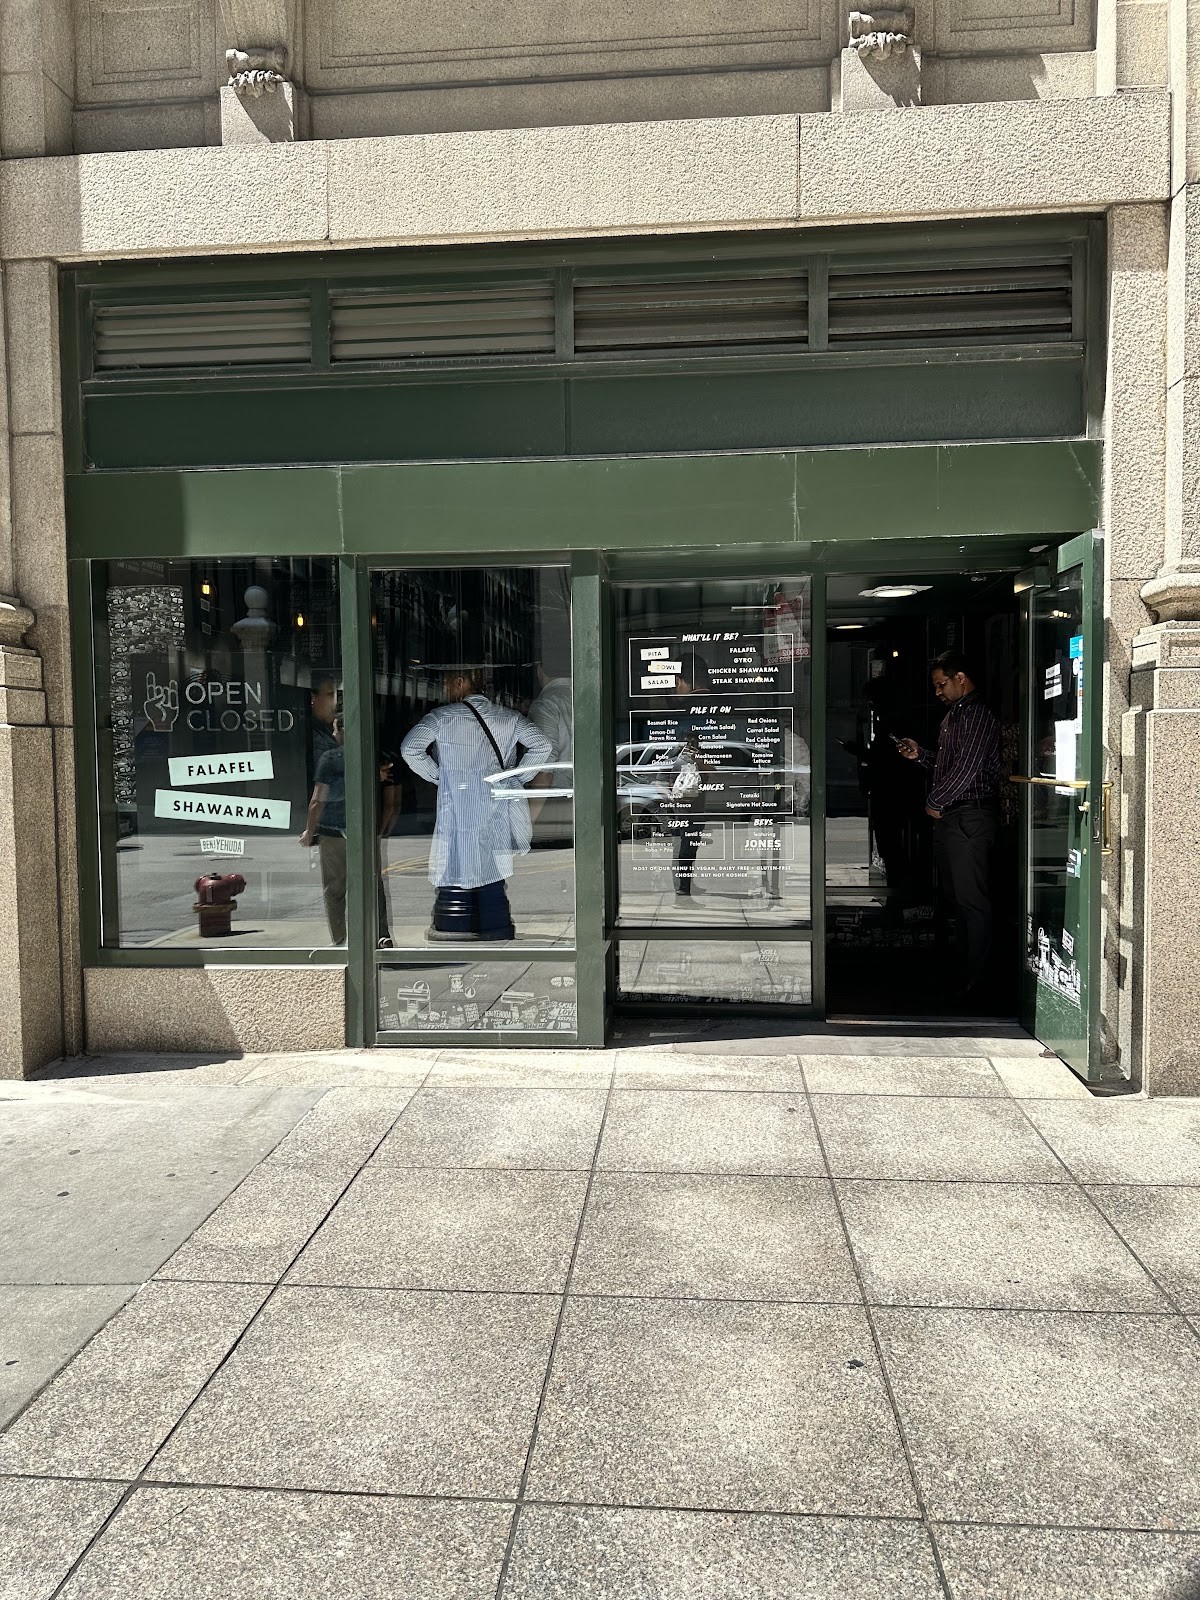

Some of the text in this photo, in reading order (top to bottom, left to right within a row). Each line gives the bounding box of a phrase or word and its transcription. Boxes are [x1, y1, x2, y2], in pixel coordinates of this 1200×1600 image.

[682, 632, 739, 642] WHAT'LL IT BE?
[185, 681, 261, 704] OPEN
[690, 706, 707, 714] PILE
[709, 706, 718, 714] IT
[187, 710, 294, 731] CLOSED
[187, 761, 254, 776] FALAFEL
[698, 783, 725, 791] SAUCES
[173, 800, 271, 819] SHAWARMA
[667, 820, 689, 828] SIDES
[744, 840, 781, 848] JONES
